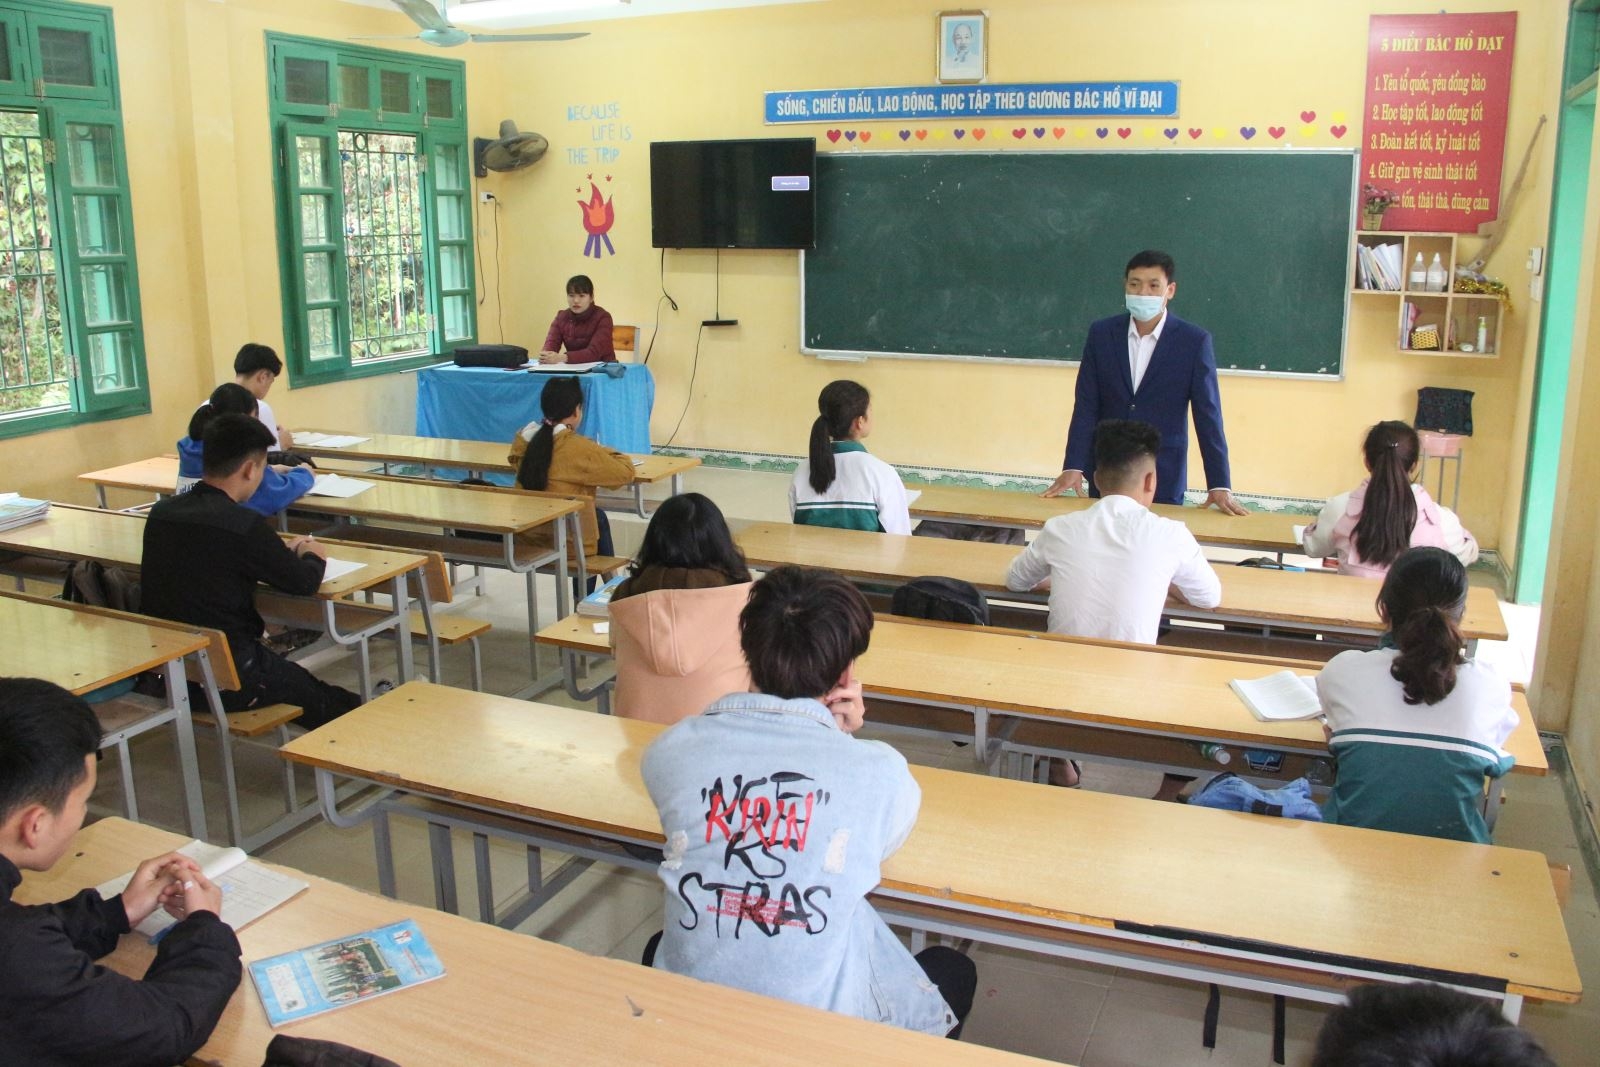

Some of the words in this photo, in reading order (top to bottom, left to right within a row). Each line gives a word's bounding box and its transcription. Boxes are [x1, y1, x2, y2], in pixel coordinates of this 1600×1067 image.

[1381, 38, 1389, 52] 5
[1392, 30, 1422, 52] ĐIỀU
[1425, 33, 1451, 52] BÁC
[1454, 30, 1474, 51] HỒ
[1477, 36, 1505, 55] DẠY
[1375, 75, 1381, 91] 1.
[1382, 73, 1398, 91] Yêu
[1400, 67, 1409, 91] tổ
[1410, 70, 1430, 96] quốc,
[1431, 73, 1447, 96] yêu
[1448, 70, 1469, 96] đồng
[1471, 72, 1486, 91] bào
[567, 102, 622, 121] BECAUSE
[777, 94, 810, 117] SỐNG,
[812, 92, 845, 114] CHIẾN
[848, 91, 874, 114] ĐẤU,
[878, 95, 899, 112] LAO
[902, 91, 938, 115] ĐỘNG,
[941, 93, 964, 114] HỌC
[968, 89, 991, 113] TẬP
[994, 92, 1024, 109] THEO
[1028, 90, 1070, 109] GƯƠNG
[1074, 87, 1100, 109] BÁC
[1103, 85, 1121, 109] HỒ
[1124, 88, 1137, 109] VĨ
[1140, 90, 1162, 112] ĐẠI
[1372, 104, 1380, 120] 2.
[1381, 103, 1398, 125] Học
[1400, 102, 1414, 125] tập
[1415, 100, 1429, 122] tốt,
[1431, 104, 1445, 120] lao
[1447, 103, 1469, 126] động
[1471, 100, 1483, 120] tốt
[592, 124, 616, 142] LIFE
[620, 126, 633, 141] IS
[1371, 133, 1377, 150] 3.
[1379, 132, 1402, 150] Đoàn
[1404, 130, 1418, 150] kết
[1420, 130, 1433, 152] tốt,
[1435, 128, 1447, 154] kỷ
[1448, 133, 1466, 155] luật
[1468, 130, 1480, 151] tốt
[566, 148, 589, 165] THE
[594, 147, 621, 164] TRIP
[1369, 165, 1376, 179] 4.
[1378, 162, 1394, 179] Giữ
[1395, 161, 1410, 183] gìn
[1412, 162, 1423, 184] vệ
[1424, 162, 1443, 180] sinh
[1445, 163, 1463, 184] thật
[1465, 160, 1478, 180] tốt
[1418, 191, 1433, 213] thật
[1435, 191, 1450, 211] thà,
[1473, 189, 1489, 210] cảm
